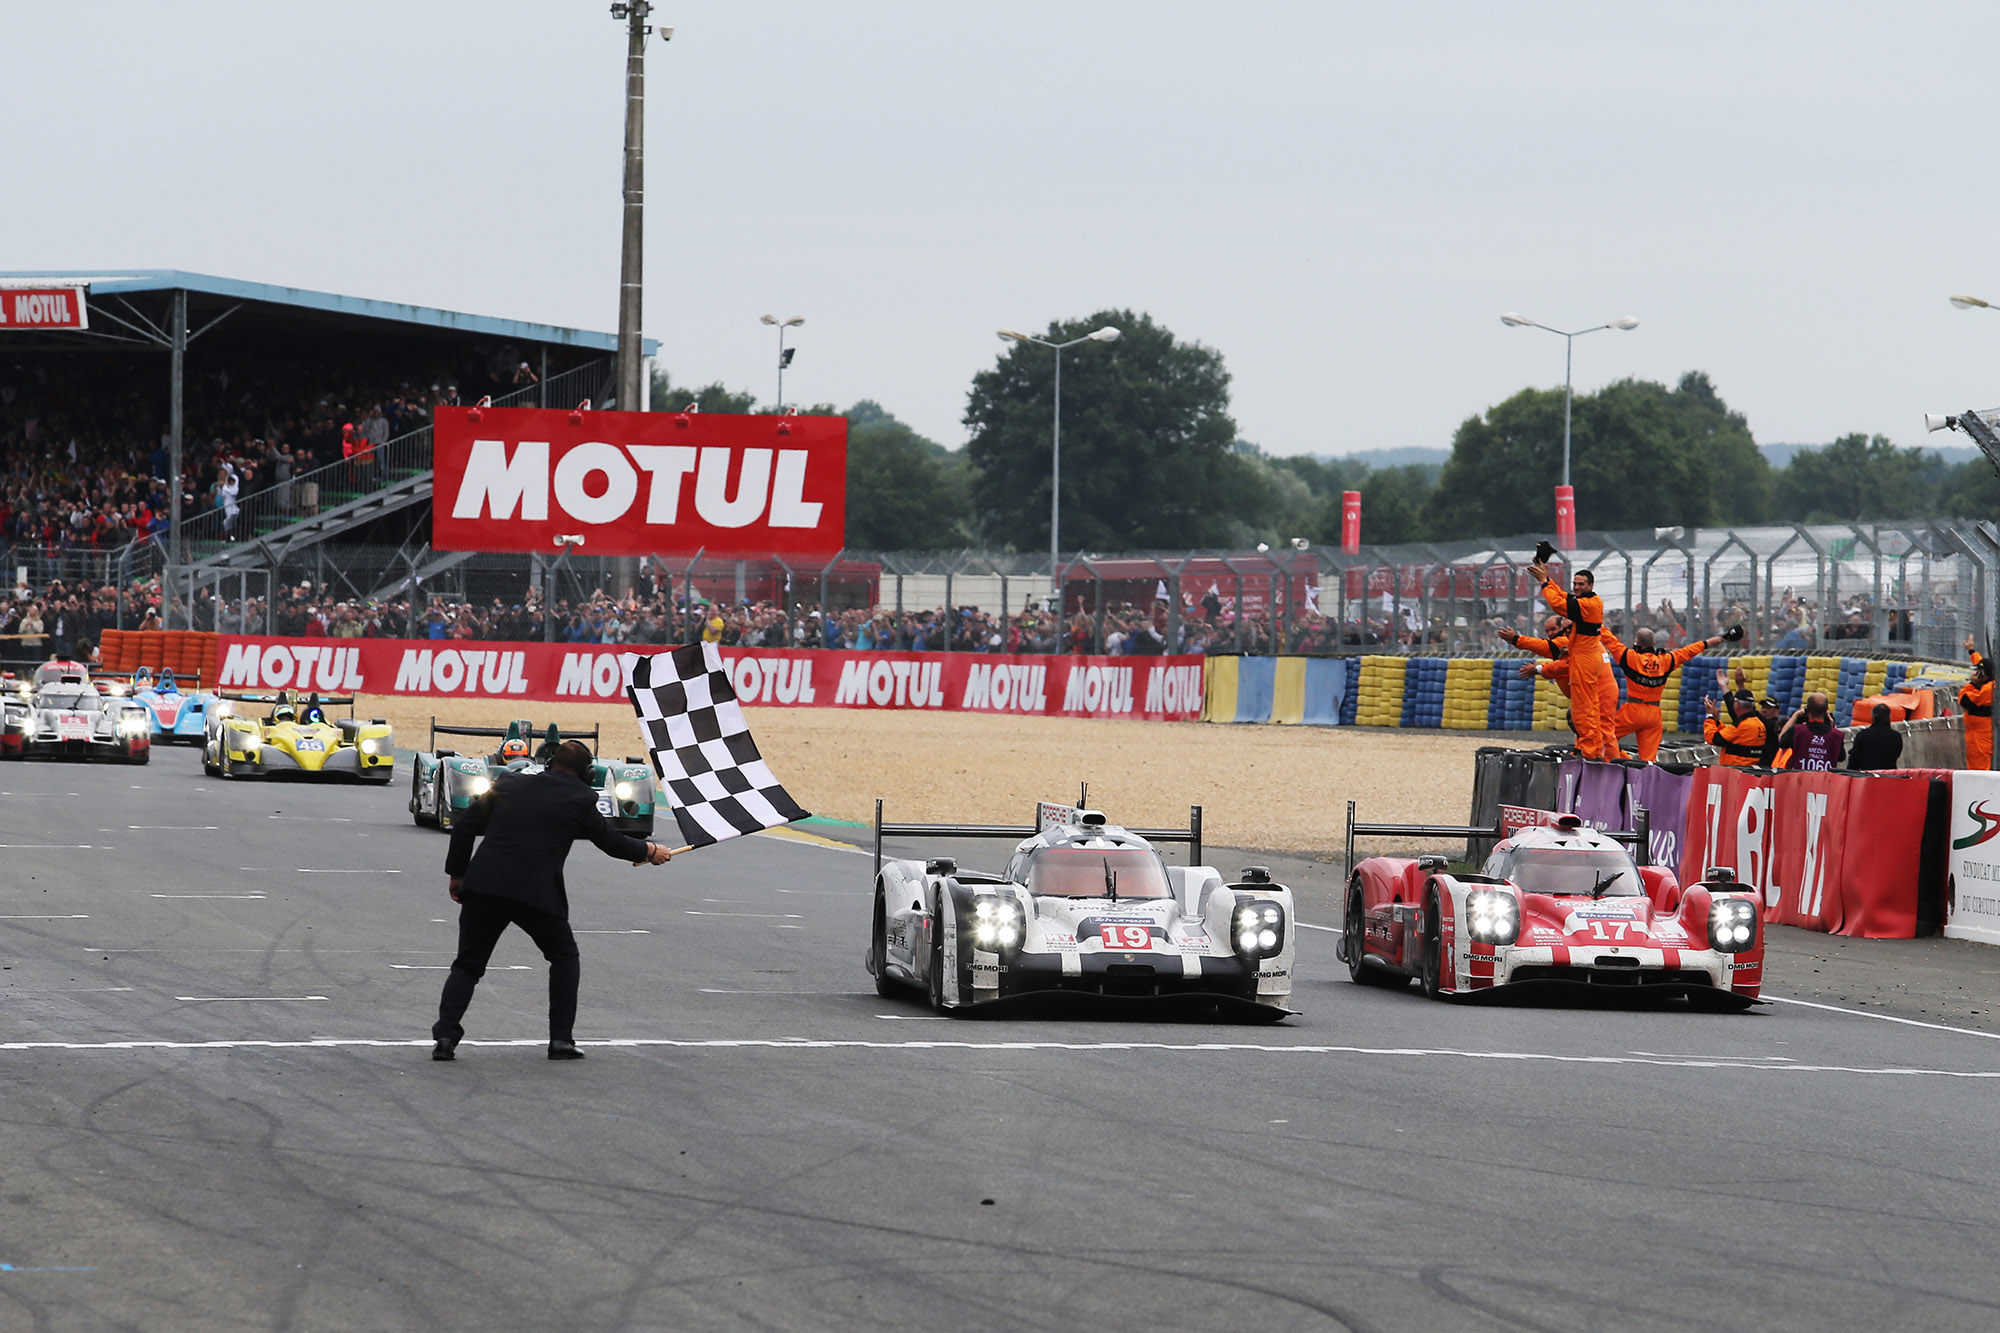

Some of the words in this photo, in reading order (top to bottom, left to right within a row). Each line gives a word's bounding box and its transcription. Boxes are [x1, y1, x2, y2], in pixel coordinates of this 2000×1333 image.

[15, 295, 71, 323] MOTUL
[451, 440, 823, 528] MOTUL
[219, 644, 364, 690] MOTUL
[394, 649, 528, 693] MOTUL
[835, 660, 944, 707] MOTUL
[962, 663, 1047, 711] MOTUL
[1145, 665, 1201, 713] MOTUL
[1063, 666, 1133, 713] MOTUL
[299, 740, 322, 750] 45
[1504, 808, 1535, 825] PORSCHE
[1963, 861, 1991, 880] SYNDICAT
[1103, 926, 1149, 948] 19
[1589, 921, 1628, 940] 17
